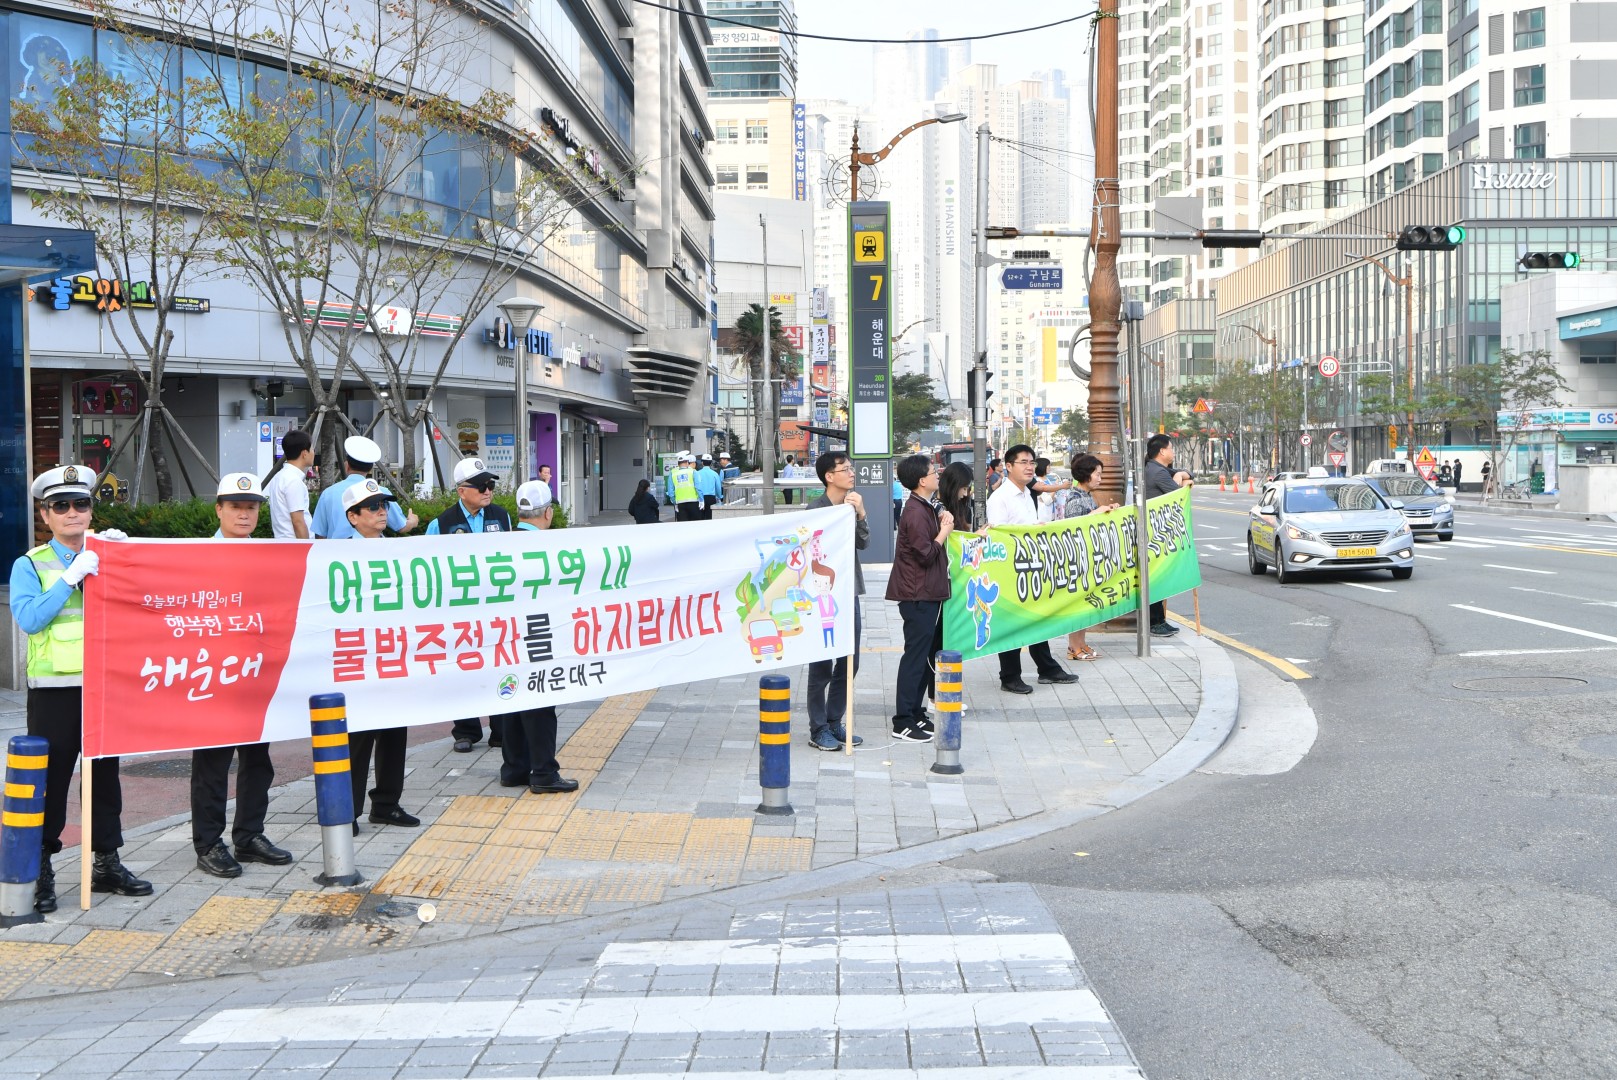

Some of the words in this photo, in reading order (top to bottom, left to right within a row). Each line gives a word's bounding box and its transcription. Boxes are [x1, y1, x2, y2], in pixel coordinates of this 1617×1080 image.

[945, 205, 955, 256] HANSHIN
[870, 274, 883, 301] 7
[1029, 269, 1061, 281] 구남로
[872, 318, 883, 360] 해운대
[496, 354, 514, 368] COFFEE
[1323, 362, 1335, 372] 60
[1010, 527, 1089, 603] 승용차요일제
[1357, 547, 1374, 556] 5601
[328, 548, 586, 614] 어린이보호구역
[599, 545, 632, 590] 내
[141, 594, 188, 608] 오늘보다
[191, 590, 228, 609] 내일이
[230, 592, 242, 608] 더
[164, 614, 222, 638] 행복한
[227, 613, 264, 634] 도시
[332, 613, 553, 683] 불법주정차를
[571, 591, 723, 657] 하지맙시다
[140, 647, 263, 702] 해운대
[527, 661, 608, 693] 해운대구
